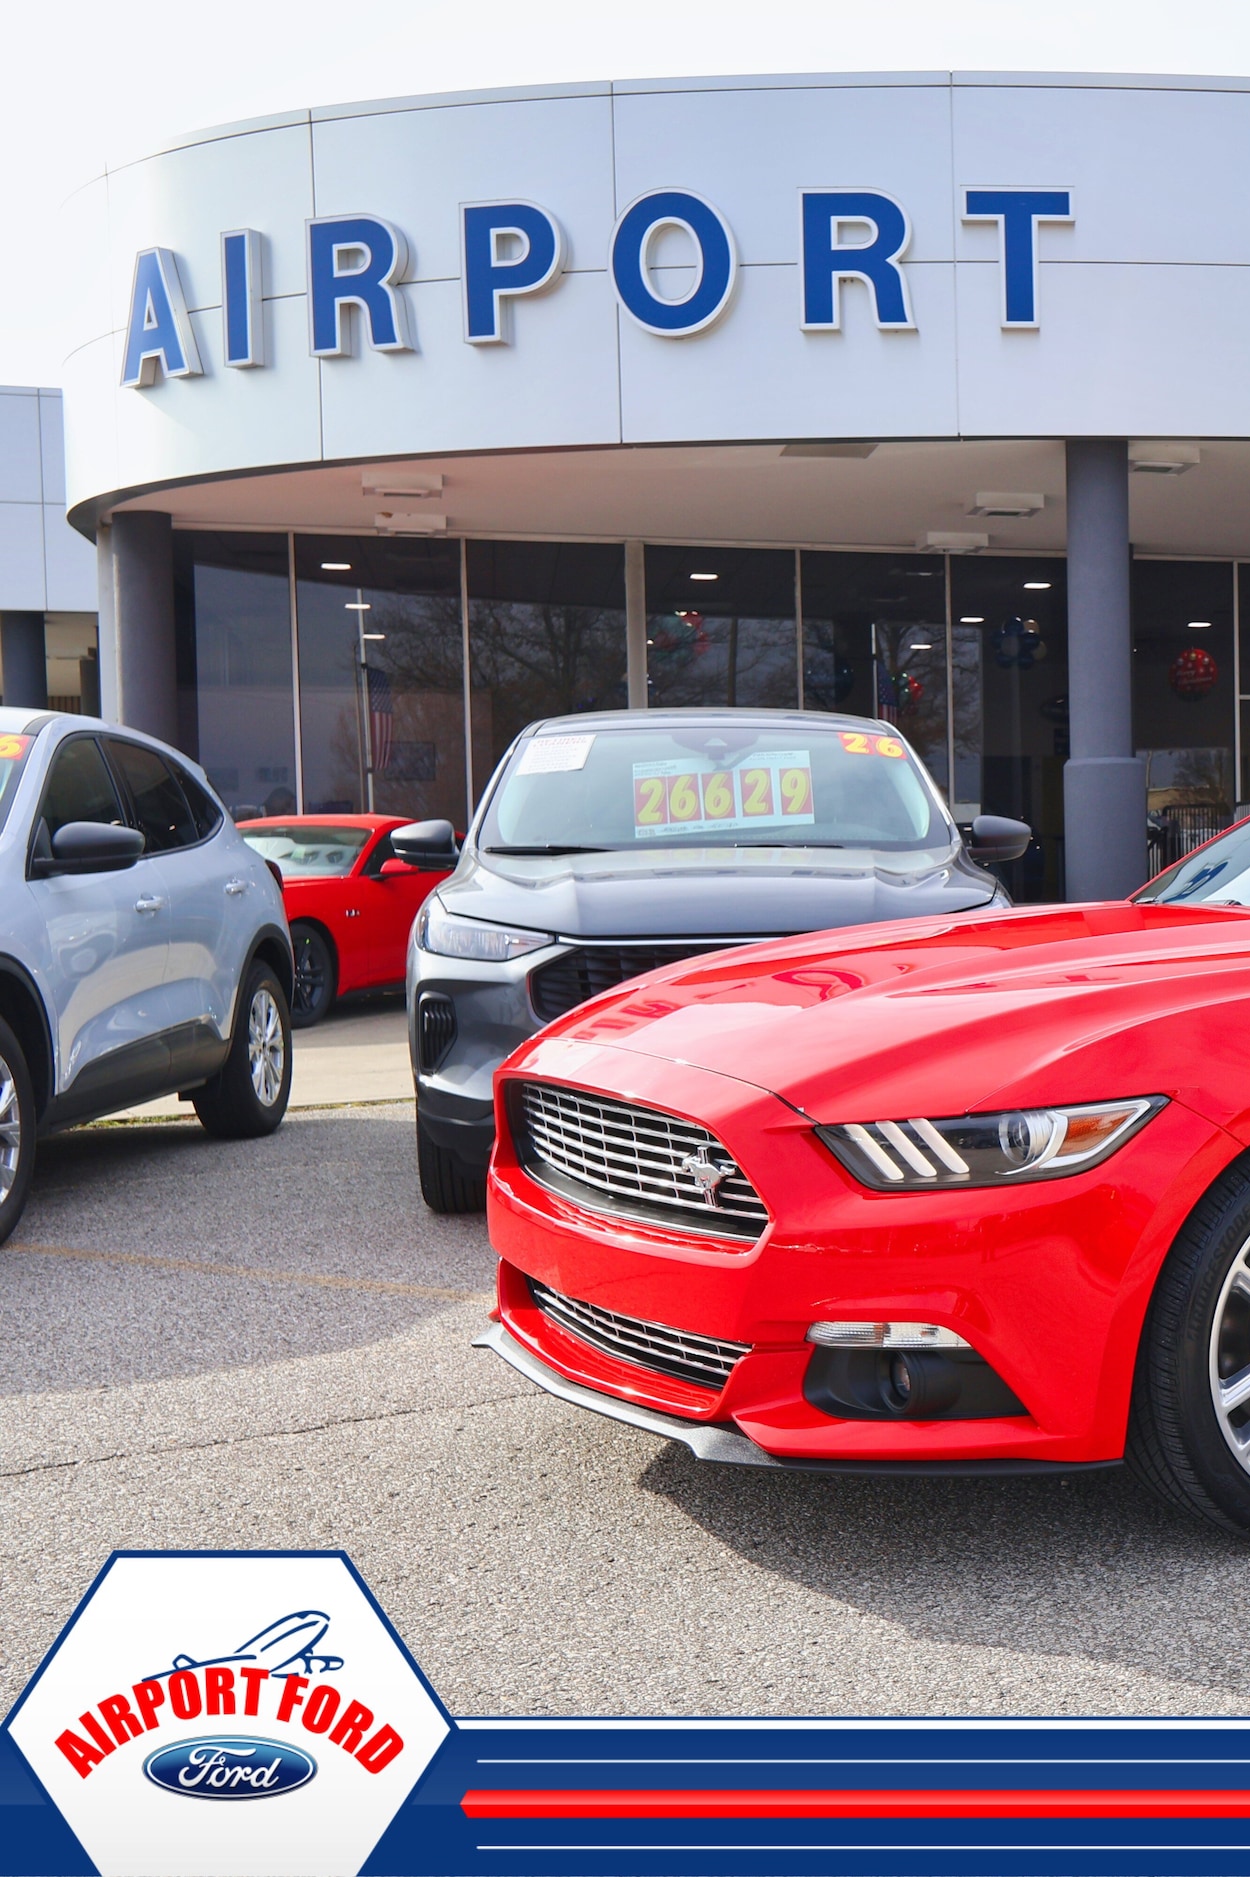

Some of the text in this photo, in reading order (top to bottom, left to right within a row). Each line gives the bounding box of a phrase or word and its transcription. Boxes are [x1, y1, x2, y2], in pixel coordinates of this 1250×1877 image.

[120, 185, 1076, 389] AIRPORT
[842, 732, 903, 758] 26
[637, 768, 810, 824] 26629
